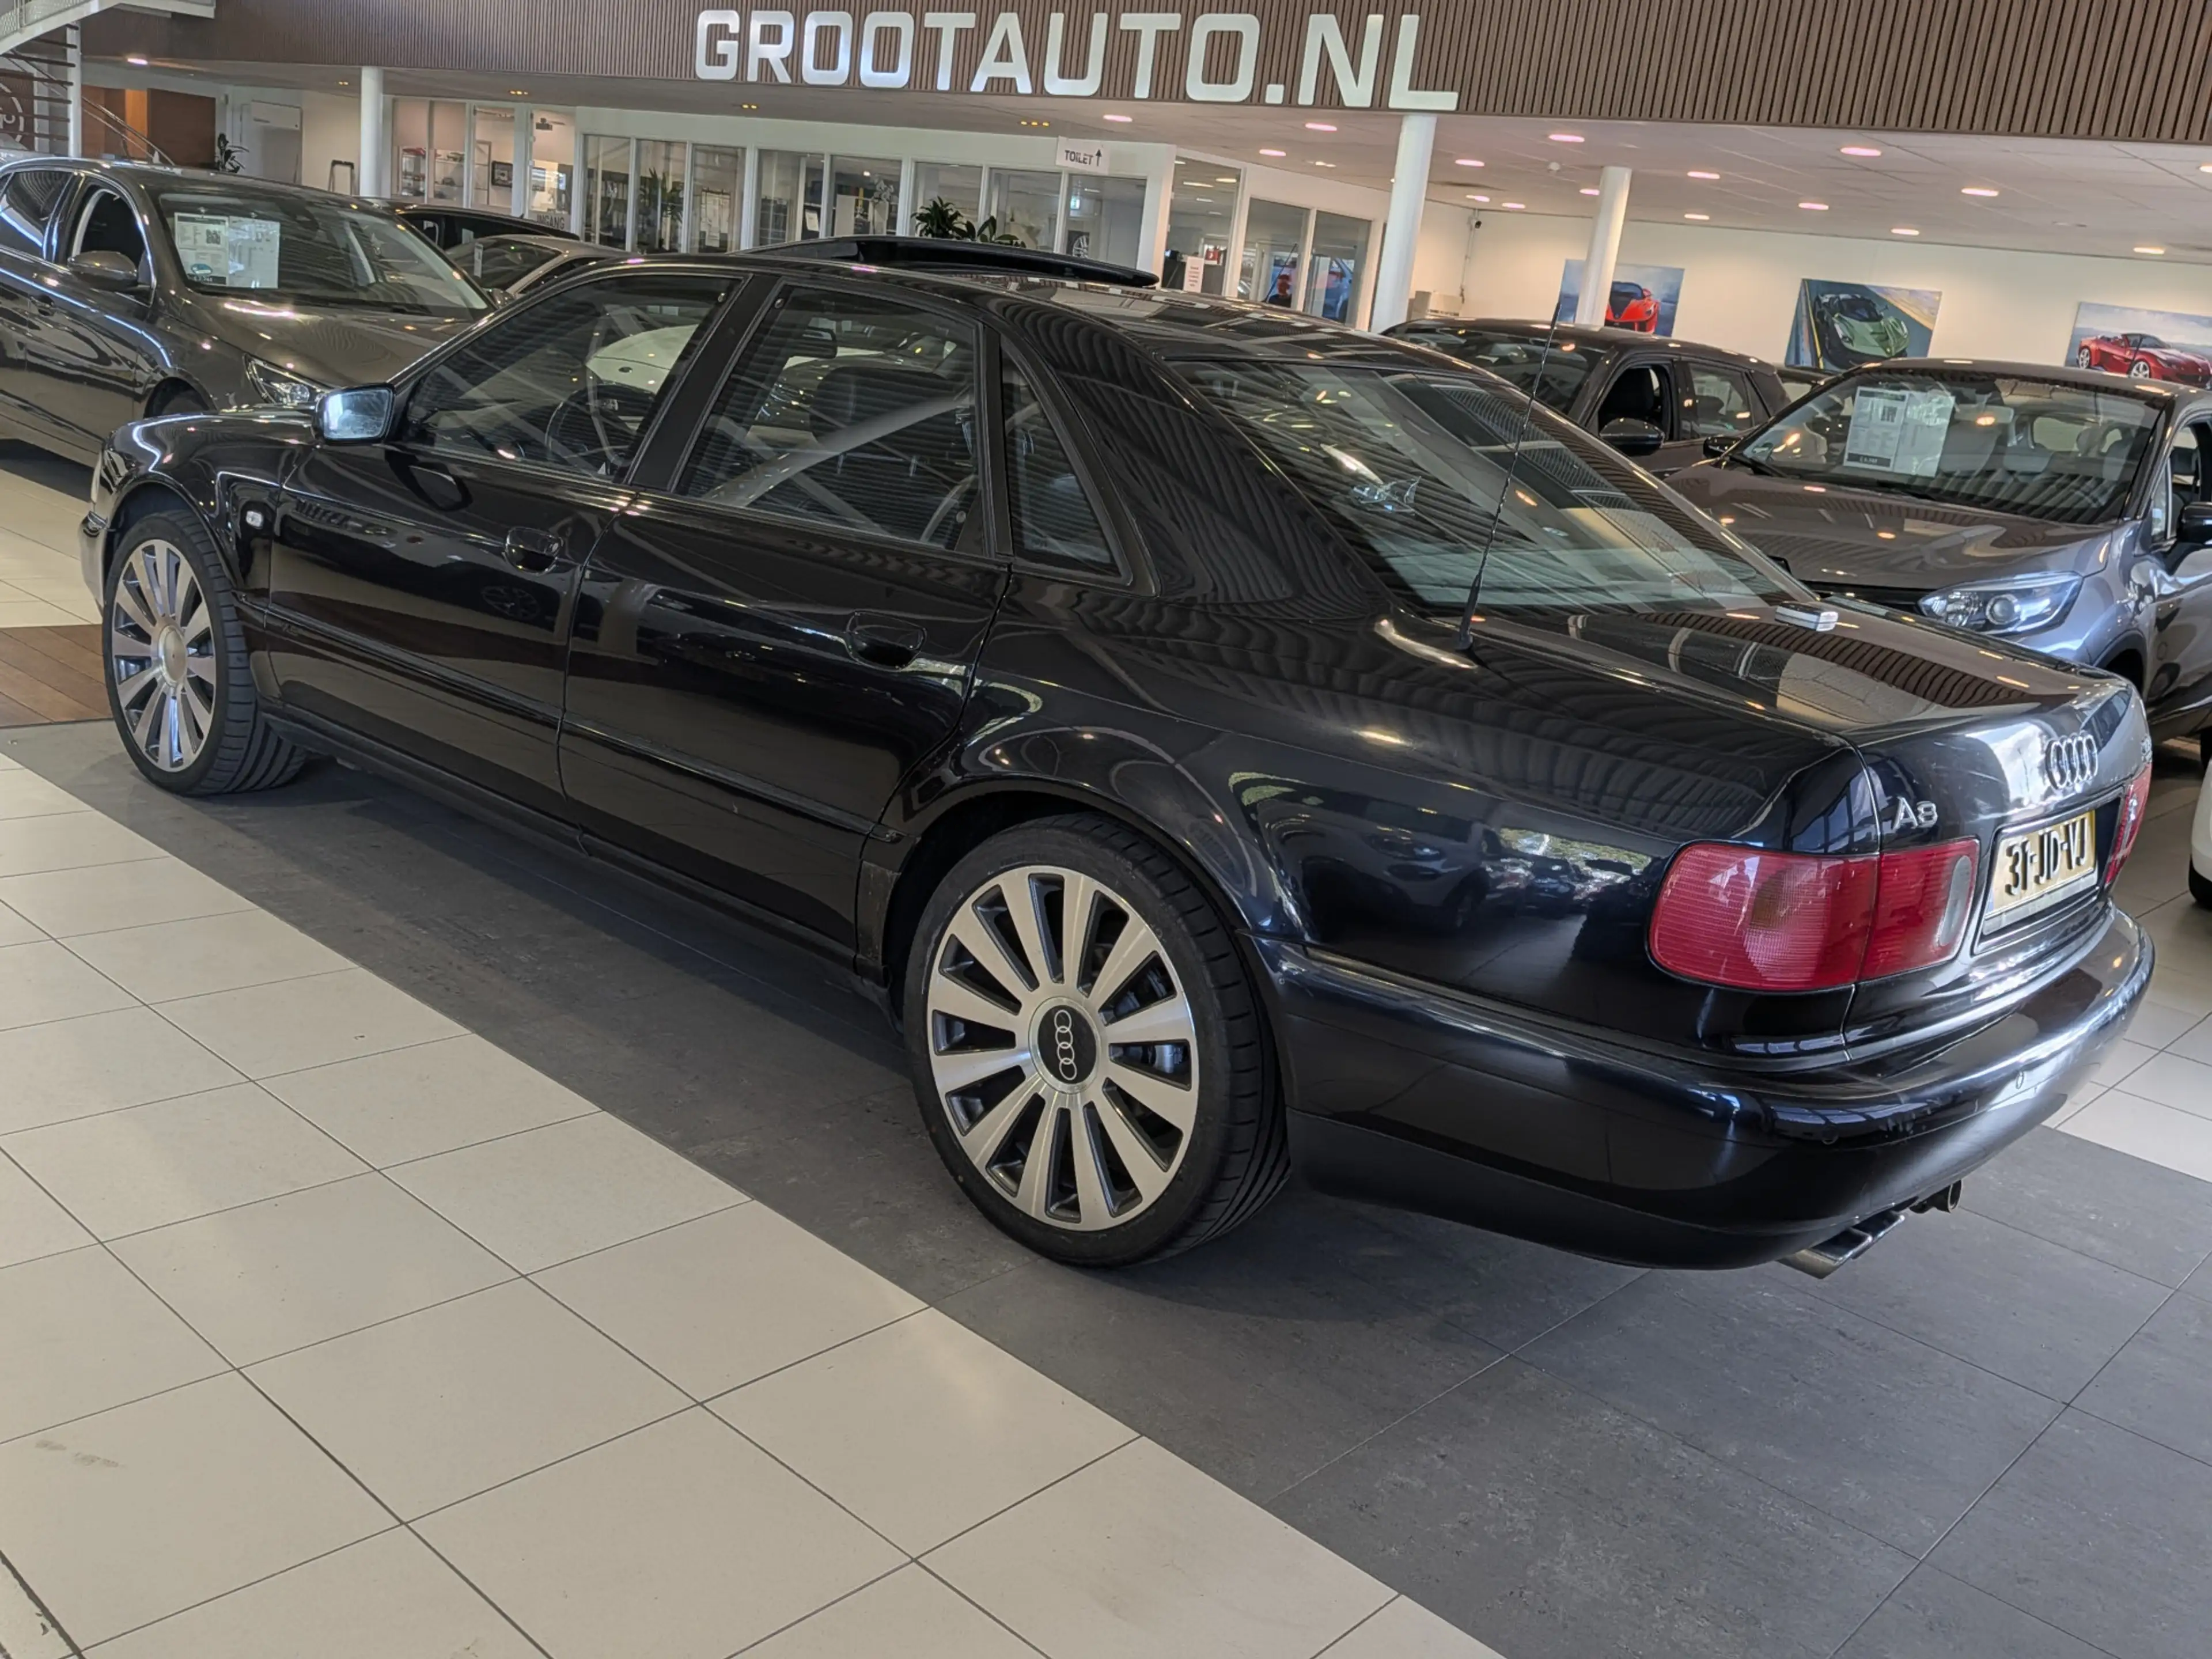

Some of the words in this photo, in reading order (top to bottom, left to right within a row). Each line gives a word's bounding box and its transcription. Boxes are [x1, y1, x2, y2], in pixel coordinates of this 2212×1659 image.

[695, 10, 1459, 111] GROOTAUTO.NL
[1065, 150, 1094, 165] TOILET
[1892, 796, 1938, 833] A8
[2005, 817, 2088, 896] 31-JD-VJ
